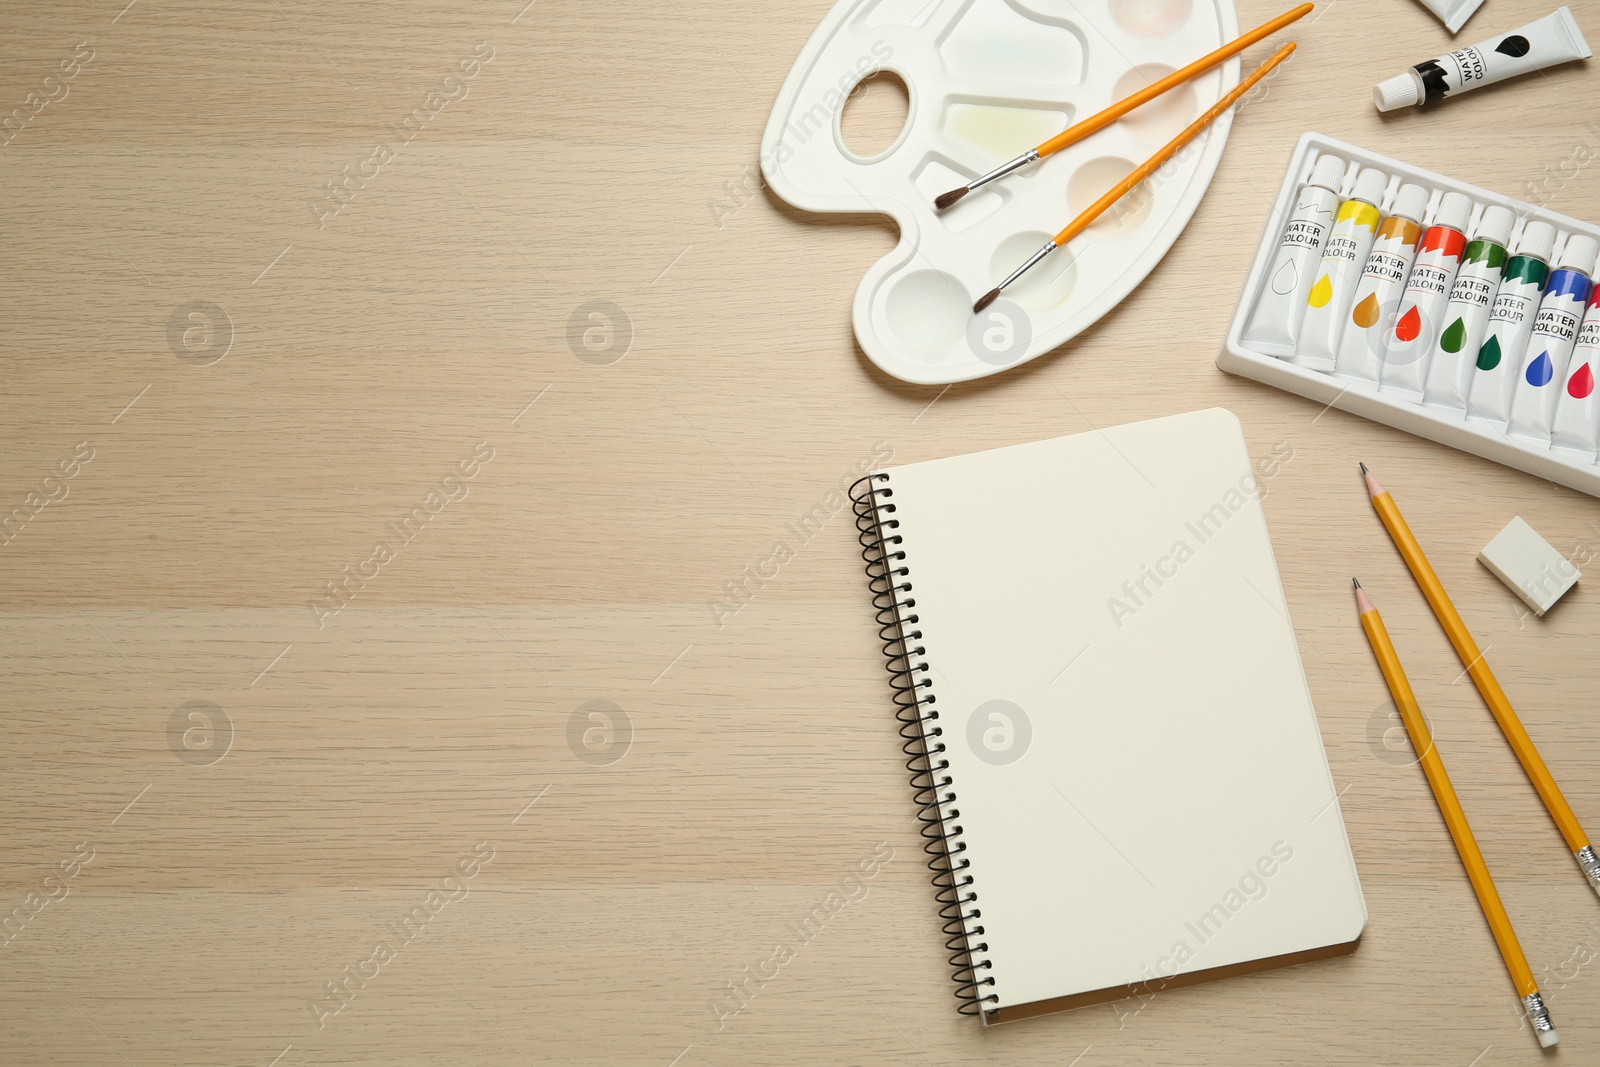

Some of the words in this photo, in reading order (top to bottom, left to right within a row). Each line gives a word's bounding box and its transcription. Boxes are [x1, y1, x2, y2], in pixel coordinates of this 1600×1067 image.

[1286, 224, 1320, 236] WATER
[1282, 234, 1319, 248] COLOUR
[1322, 249, 1356, 261] OLOUR
[1368, 255, 1404, 269] WATER
[1363, 265, 1402, 281] COLOUR
[1411, 269, 1446, 282] WATER
[1406, 280, 1445, 293] COLOUR
[1453, 280, 1490, 294] WATER
[1449, 291, 1489, 305] COLOUR
[1495, 298, 1525, 310] ATER
[1490, 308, 1524, 321] OLOUR
[1538, 312, 1575, 328] WATER
[1532, 322, 1574, 340] COLOUR
[1580, 324, 1600, 334] WAT
[1575, 335, 1600, 345] COLO
